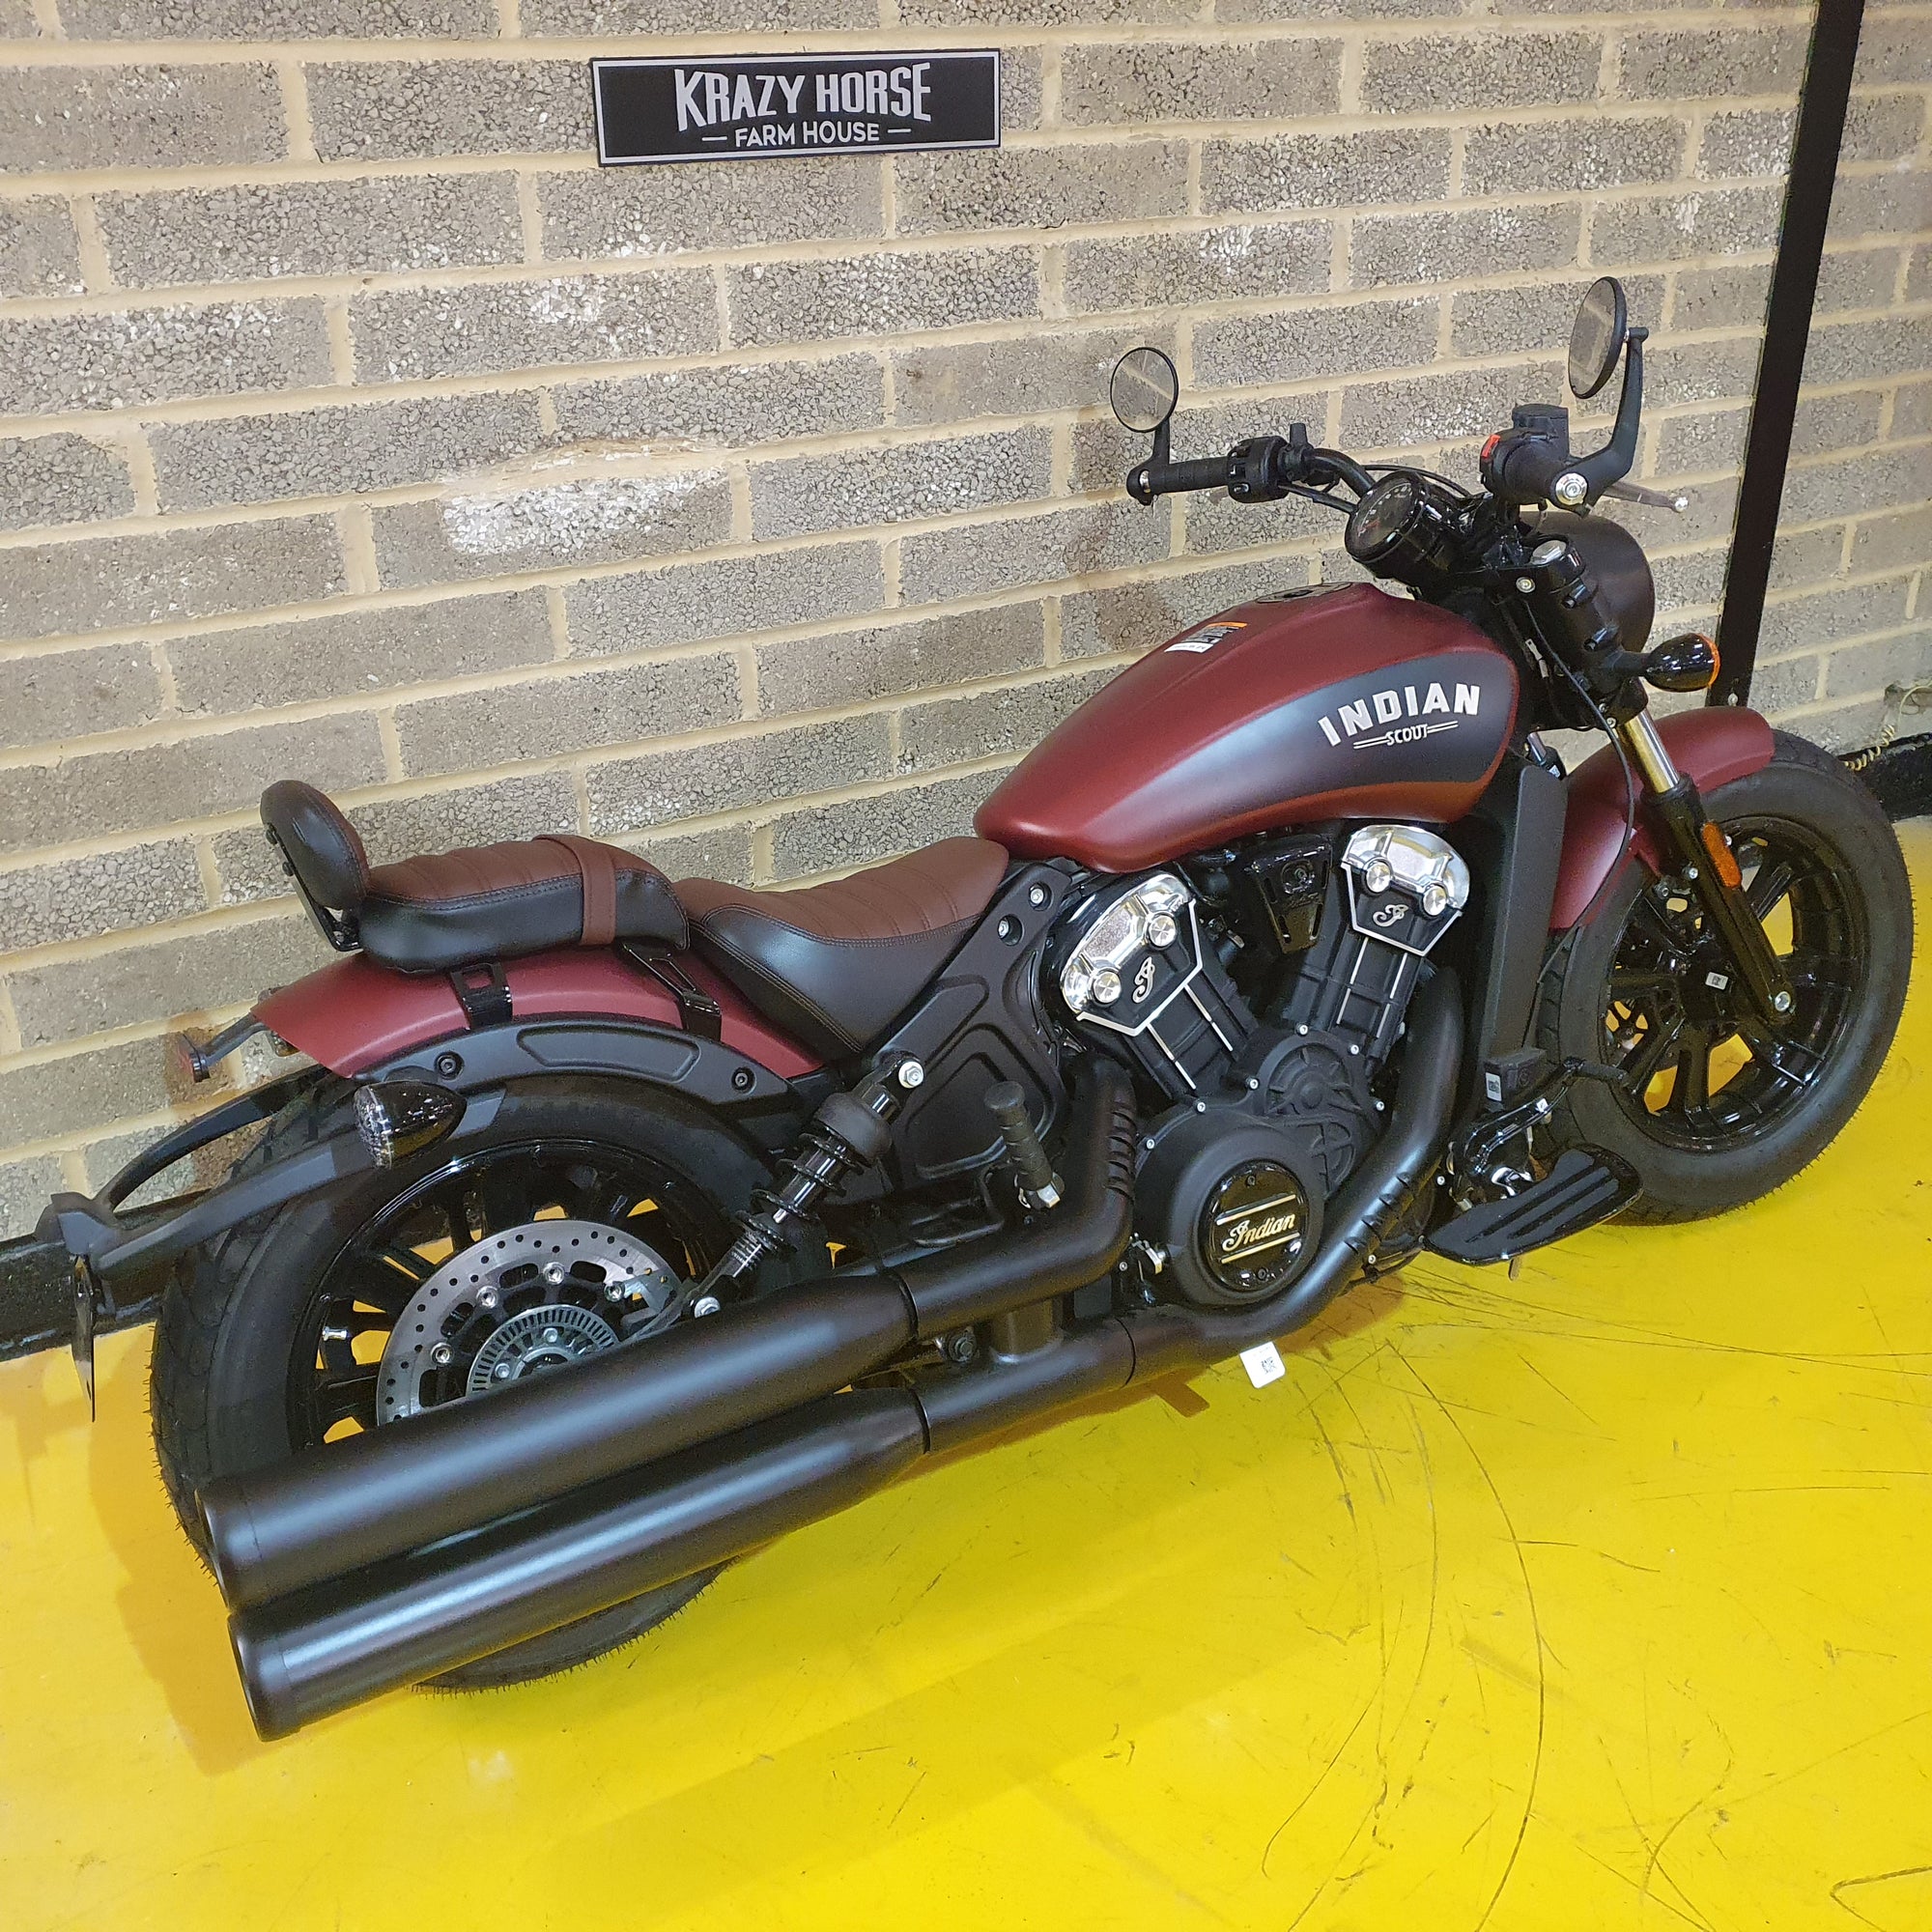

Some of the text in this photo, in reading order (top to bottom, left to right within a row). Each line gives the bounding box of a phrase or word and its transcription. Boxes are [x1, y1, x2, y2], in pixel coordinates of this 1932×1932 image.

[674, 62, 931, 131] KRAZY HORSE
[734, 121, 880, 147] FARM HOUSE
[1318, 682, 1481, 747] INDIAN
[1385, 724, 1429, 746] SCOUT
[1221, 1213, 1295, 1252] Indian
